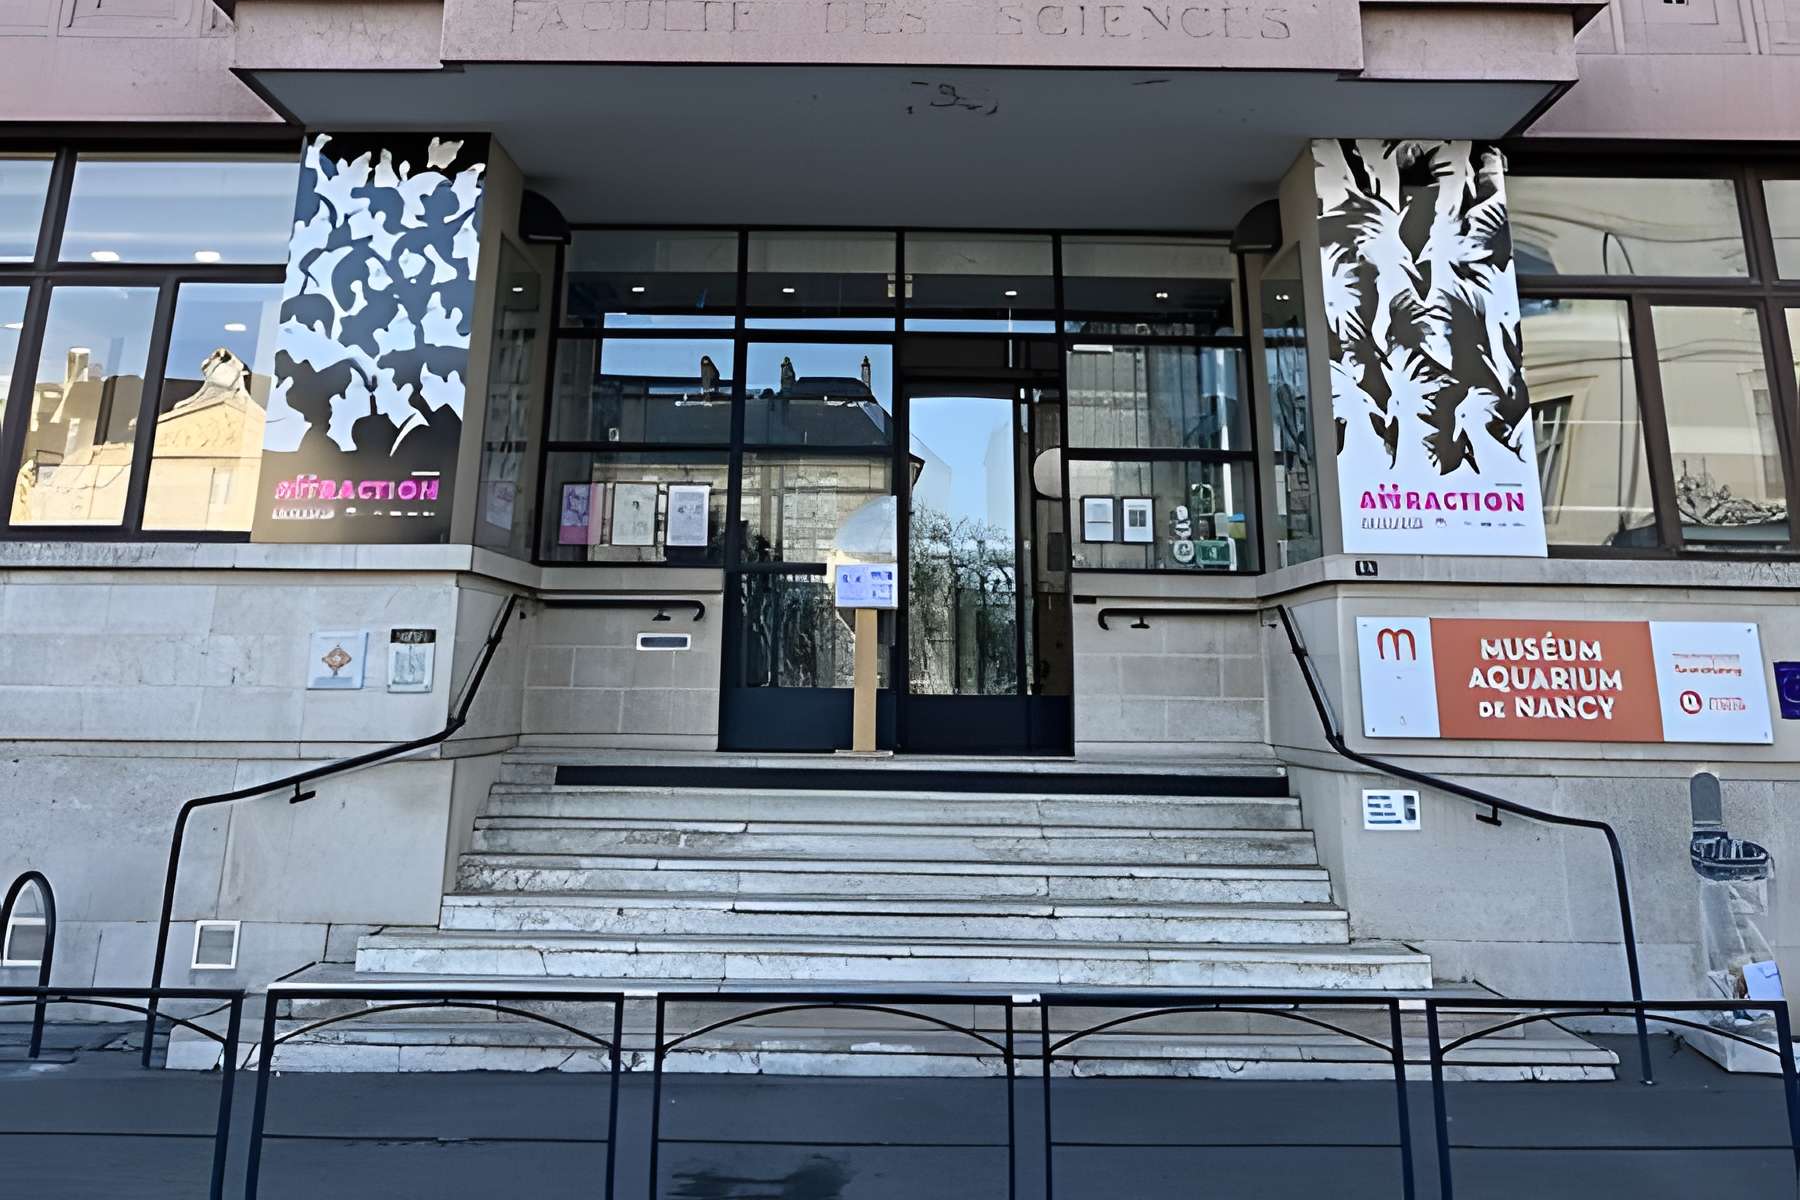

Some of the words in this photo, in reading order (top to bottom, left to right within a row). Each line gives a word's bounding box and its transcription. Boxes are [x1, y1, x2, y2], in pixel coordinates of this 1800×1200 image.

[1480, 630, 1603, 662] MUSÉUM
[1467, 664, 1624, 693] AQUARIUM
[1514, 694, 1616, 721] NANCY
